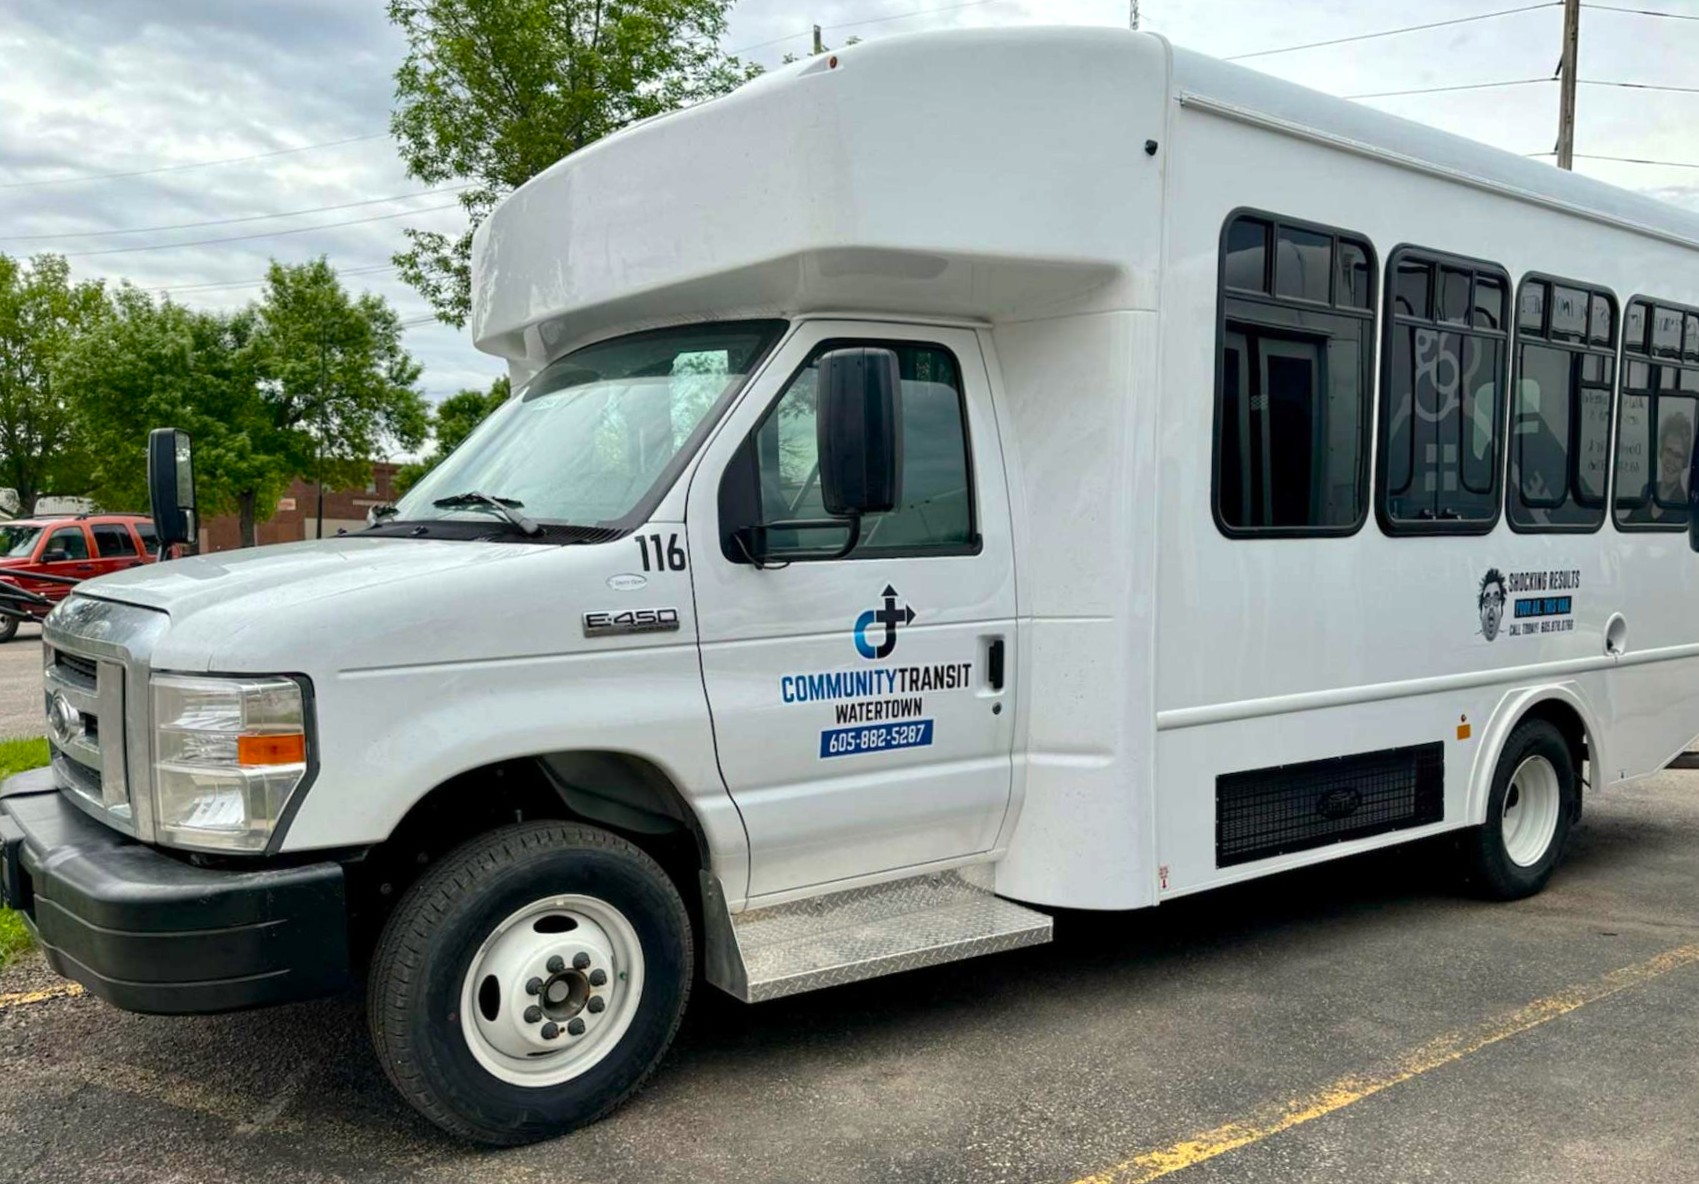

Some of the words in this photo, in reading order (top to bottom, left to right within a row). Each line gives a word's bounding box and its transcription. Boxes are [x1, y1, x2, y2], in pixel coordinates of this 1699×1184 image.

[635, 533, 686, 571] 116
[1509, 571, 1547, 592] SHOCKING
[1549, 569, 1580, 590] RESULTS
[836, 698, 922, 724] WATERTOWN
[829, 727, 926, 752] 605-882-5287
